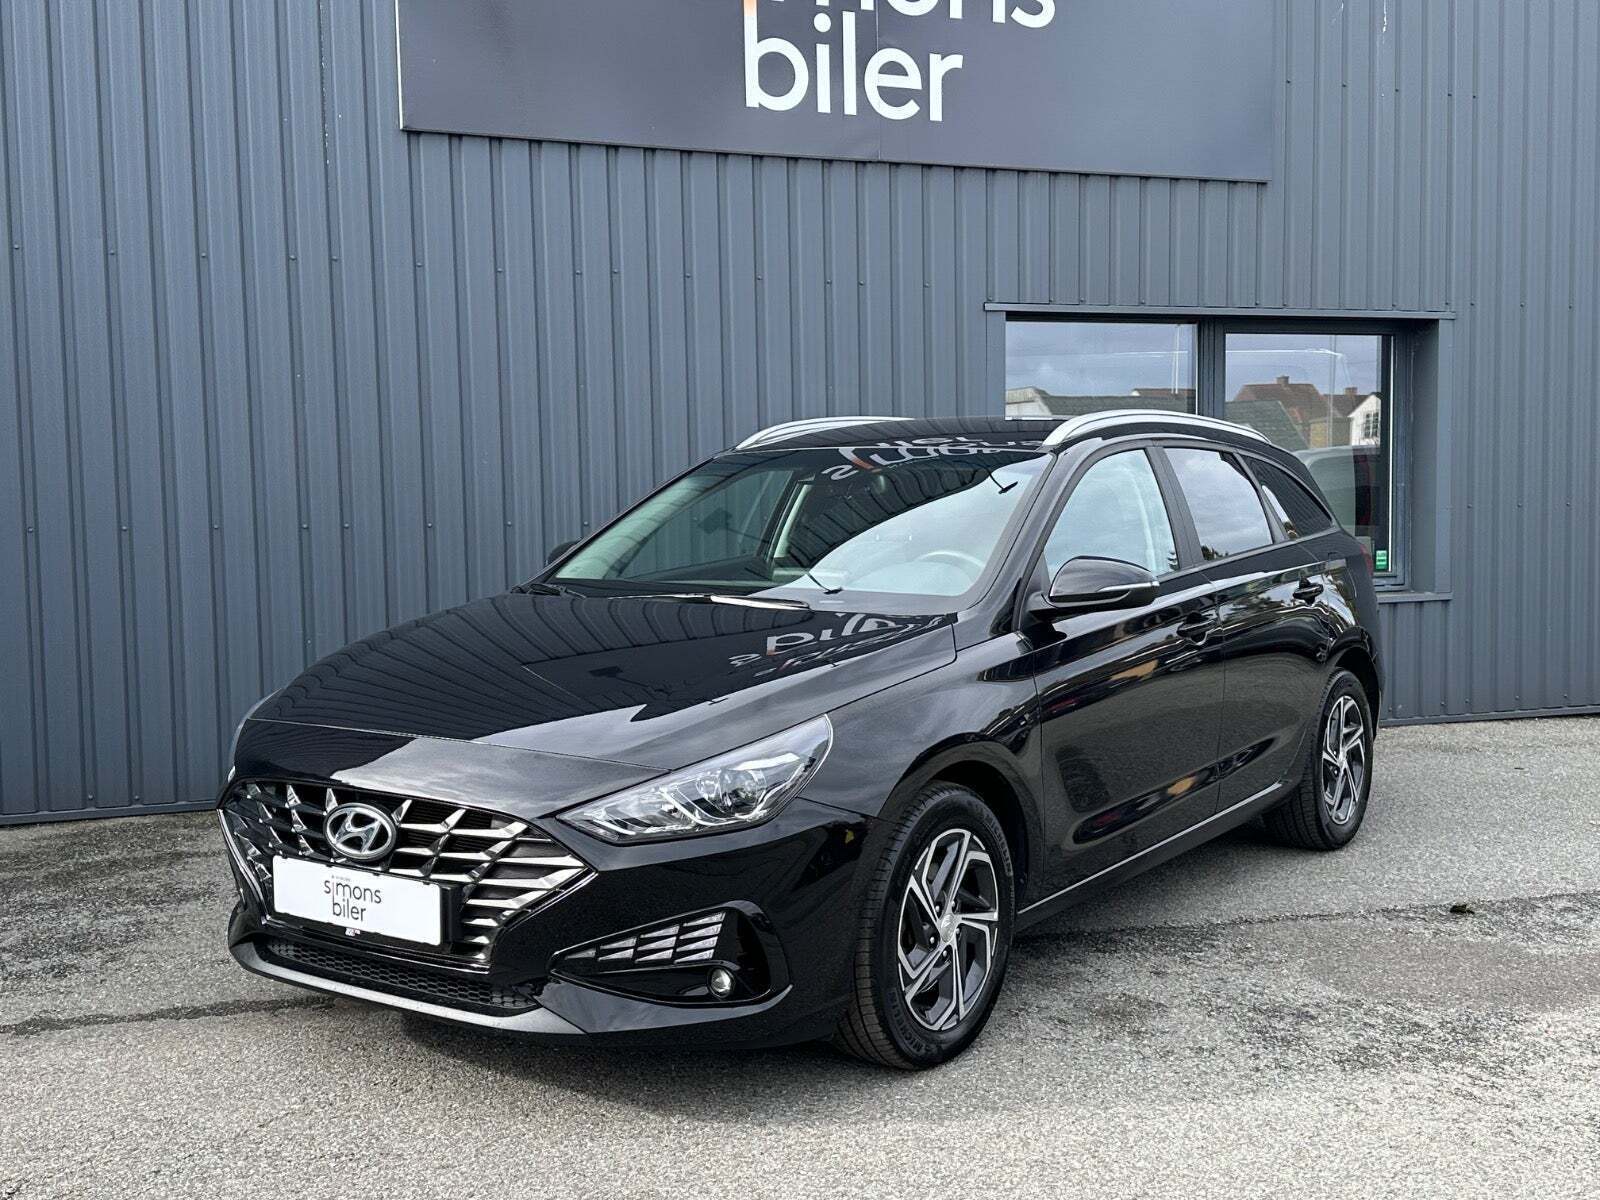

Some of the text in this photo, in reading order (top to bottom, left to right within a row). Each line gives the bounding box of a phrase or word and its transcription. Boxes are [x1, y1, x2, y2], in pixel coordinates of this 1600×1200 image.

[743, 5, 964, 122] biler
[324, 874, 381, 903] simons
[332, 897, 366, 921] biler
